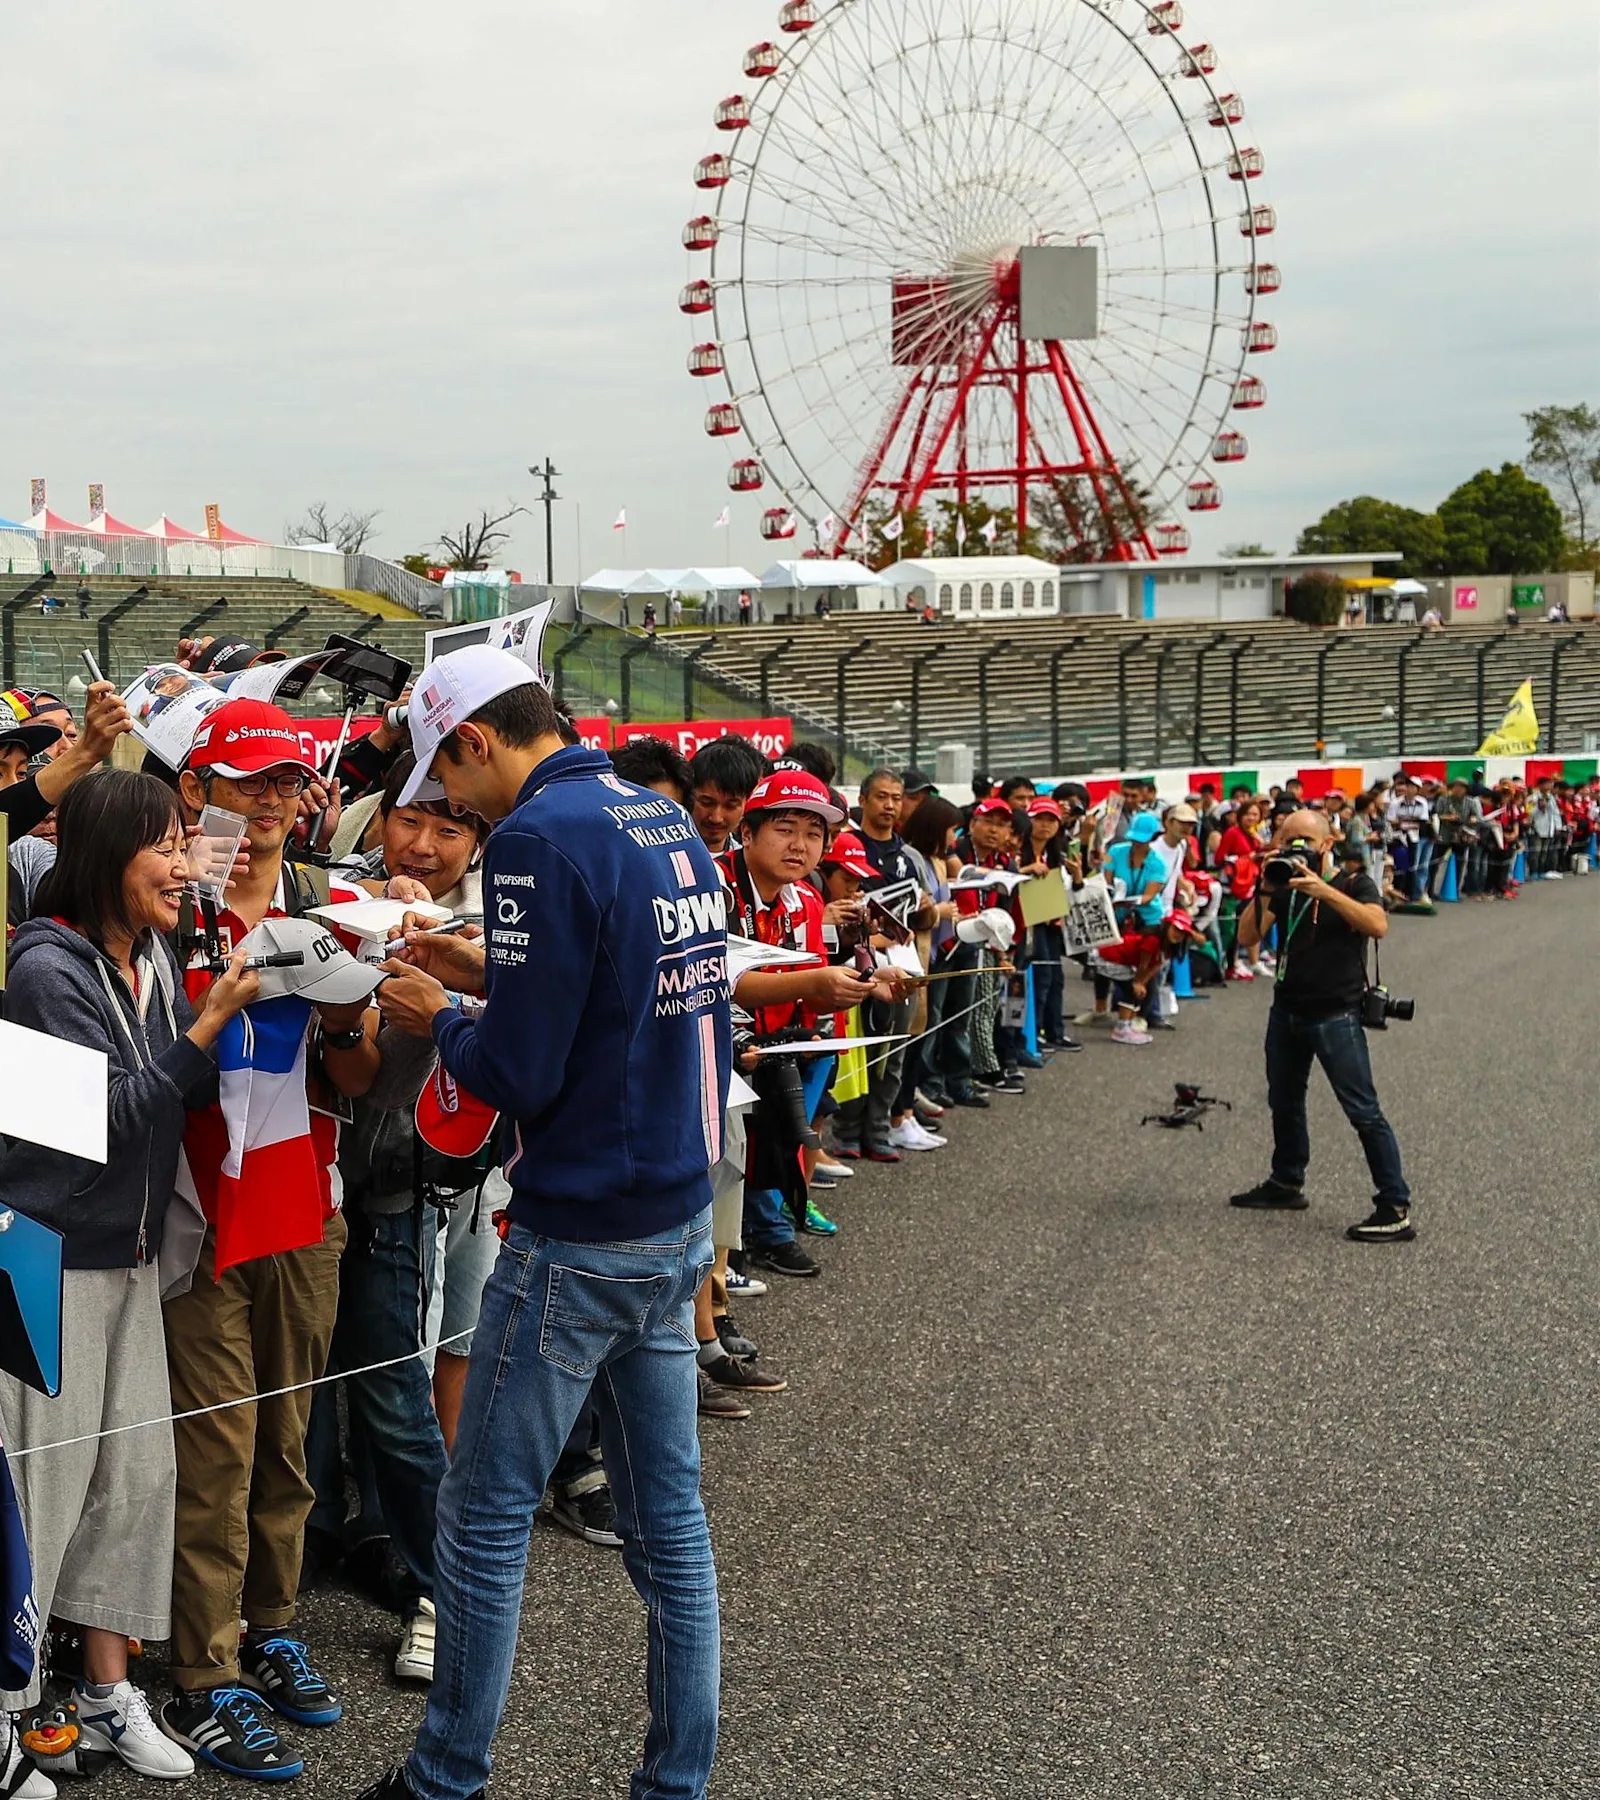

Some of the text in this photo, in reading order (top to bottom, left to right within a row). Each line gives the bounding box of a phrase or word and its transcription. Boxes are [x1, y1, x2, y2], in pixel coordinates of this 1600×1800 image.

[240, 725, 298, 743] Santander
[602, 799, 674, 830] JOHNNIE
[625, 823, 690, 848] WALKER
[744, 904, 755, 936] Canon
